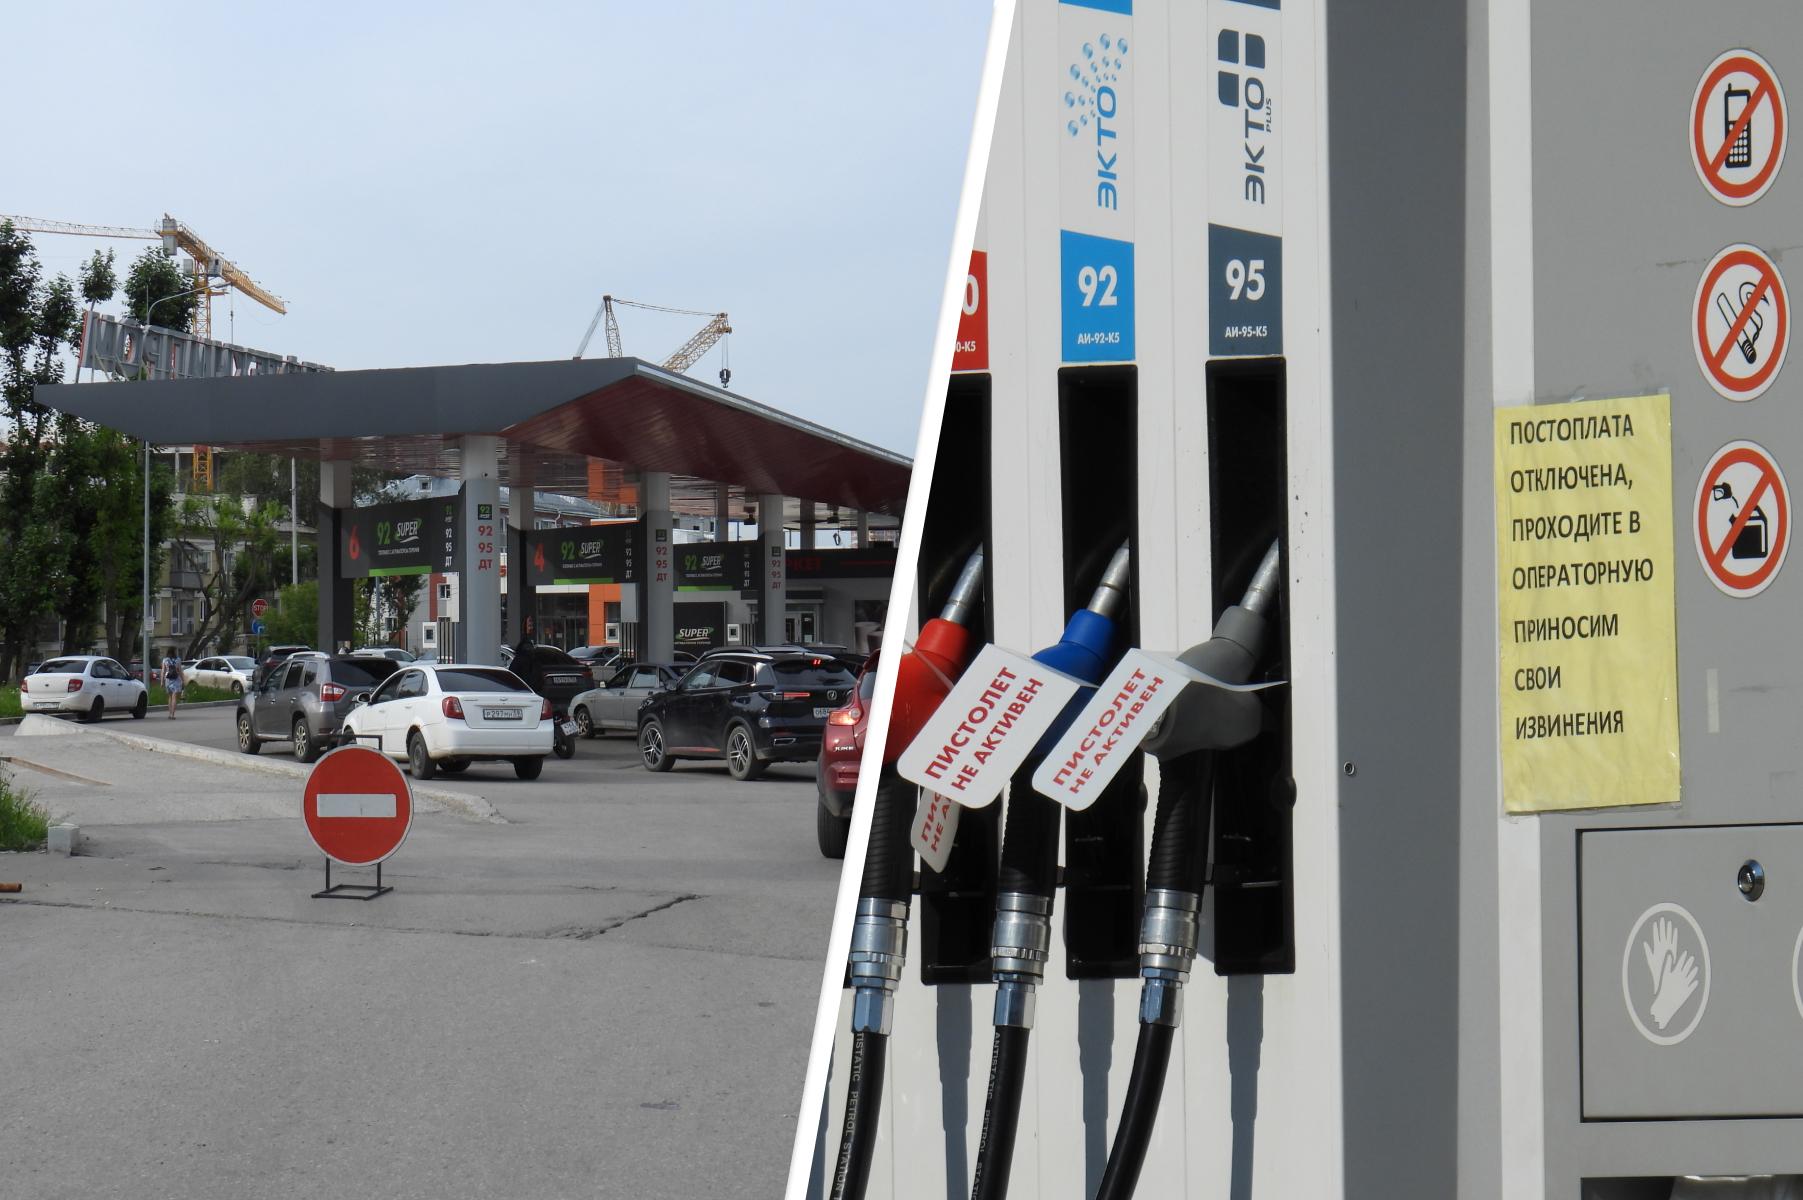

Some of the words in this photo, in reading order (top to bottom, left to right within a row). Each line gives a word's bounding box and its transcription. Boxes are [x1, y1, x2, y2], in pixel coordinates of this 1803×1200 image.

[1097, 85, 1117, 211] ЭКТО
[1245, 77, 1265, 205] ЭКТО
[1078, 265, 1118, 307] 92
[1225, 259, 1265, 301] 95
[1077, 332, 1120, 345] АИ-92-К5
[1225, 325, 1268, 338] АИ-95-К5
[1510, 414, 1634, 445] ПОСТОПЛАТА
[1511, 463, 1633, 493] ОТКЛЮЧЕНА,
[377, 522, 390, 545] 92
[396, 521, 418, 537] SUPER
[478, 525, 493, 537] 92
[1512, 511, 1622, 542] ПРОХОДИТЕ
[1629, 511, 1641, 533] В
[350, 525, 360, 560] 6
[478, 542, 493, 553] 95
[561, 542, 575, 560] 92
[581, 542, 601, 554] SUPER
[656, 547, 667, 555] 92
[478, 559, 493, 570] ДТ
[534, 544, 545, 572] 4
[656, 560, 667, 569] 95
[656, 573, 667, 582] ДТ
[1512, 558, 1654, 590] ОПЕРАТОРНУЮ
[253, 604, 267, 612] STOP
[679, 628, 708, 638] SUPER
[1514, 613, 1619, 643] ПРИНОСИМ
[1515, 666, 1561, 691] СВОИ
[924, 666, 1017, 779] ПИСТОЛЕТ
[951, 764, 979, 791] НЕ
[974, 678, 1044, 766] АКТИВЕН
[1053, 668, 1147, 786] ПИСТОЛЕТ
[1069, 767, 1094, 794] НЕ
[1094, 676, 1165, 766] АКТИВЕН
[1516, 710, 1624, 740] ИЗВИНЕНИЯ
[931, 822, 943, 852] НЕ
[845, 1091, 859, 1137] PETROL
[834, 1142, 853, 1191] STATION
